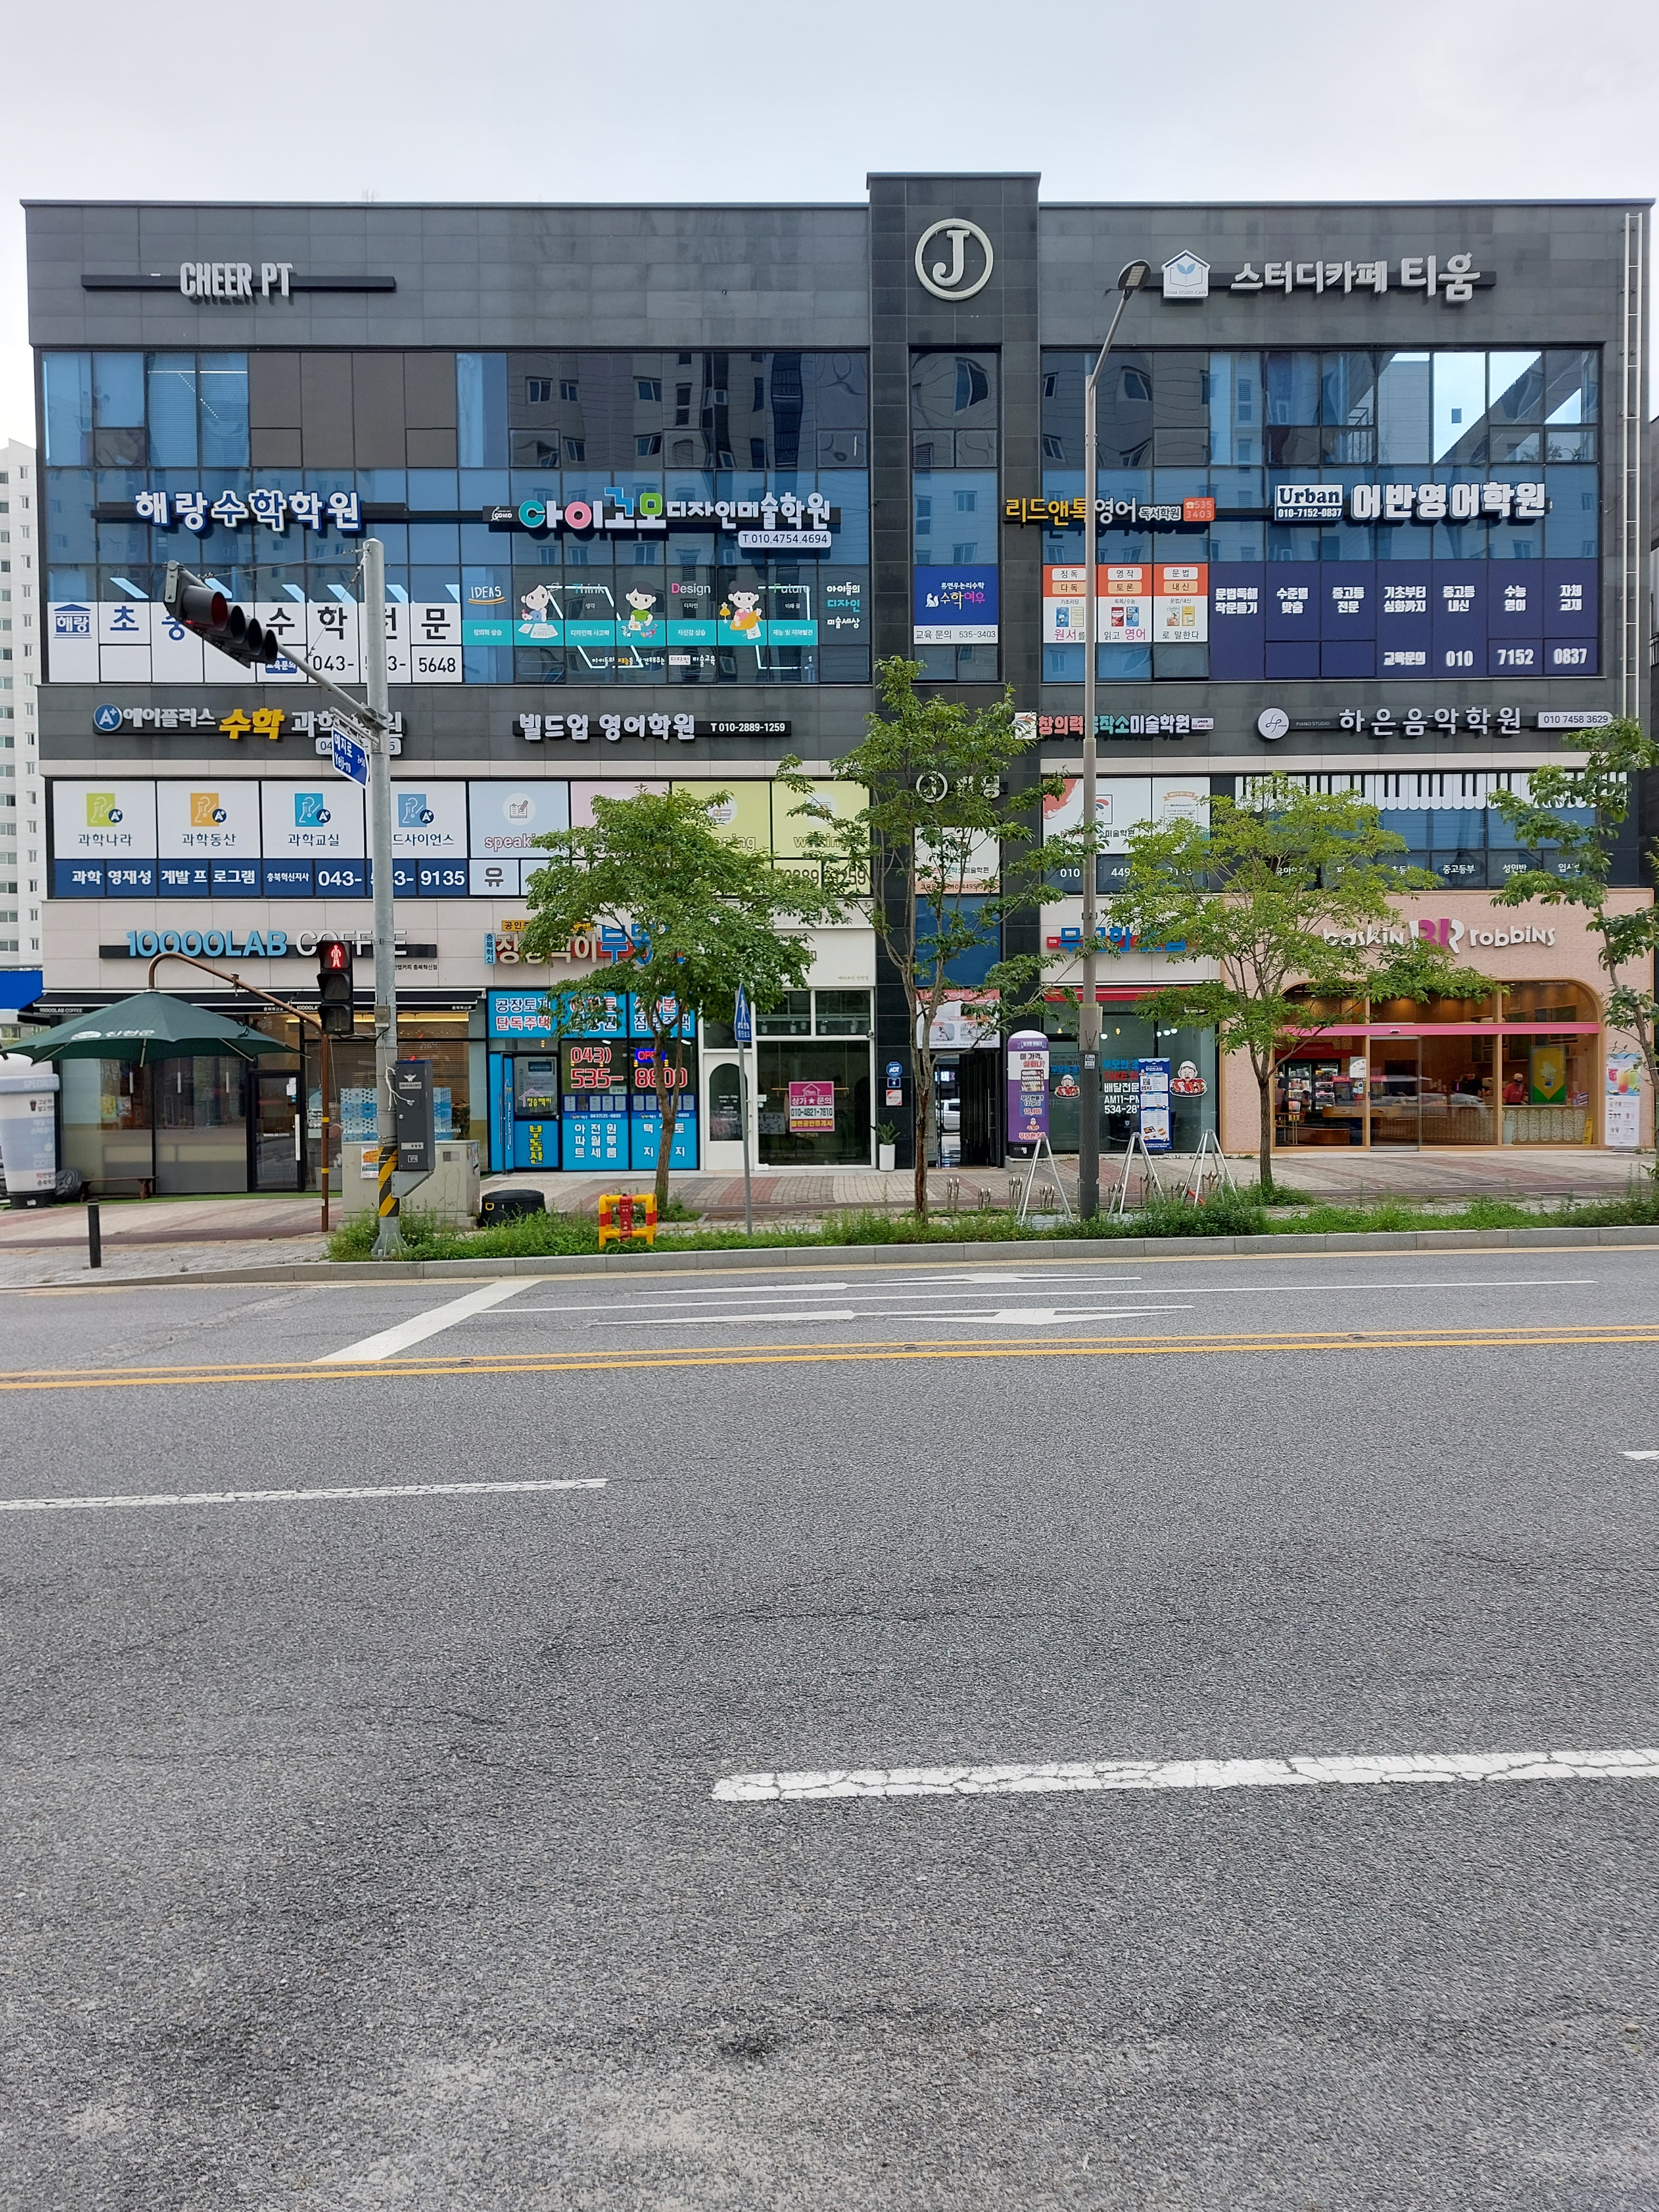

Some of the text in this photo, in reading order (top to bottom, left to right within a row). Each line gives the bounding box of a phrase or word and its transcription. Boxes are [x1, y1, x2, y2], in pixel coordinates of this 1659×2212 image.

[933, 230, 970, 286] J
[180, 261, 293, 297] CHEER PT
[1231, 252, 1481, 302] 스터디카페 티움
[1279, 487, 1340, 505] Urban
[1351, 482, 1546, 520] 어반영어학원
[135, 489, 362, 532] 해랑수학학원
[666, 492, 830, 530] 디자인미술학원
[1195, 500, 1212, 509] 535
[1139, 506, 1182, 521] 독서학원
[1186, 510, 1212, 519] 3403
[1278, 508, 1342, 518] 010-7152-0837
[1061, 569, 1078, 579] 정독
[1116, 569, 1135, 578] 영작
[1172, 569, 1190, 578] 문법
[470, 586, 501, 598] IDEAS
[671, 583, 711, 596] Design
[826, 581, 861, 596] 아이들의
[1061, 583, 1078, 593] 다독
[1116, 583, 1135, 592] 토론
[1172, 582, 1190, 591] 내신
[1215, 587, 1259, 600] 문법독해
[1276, 586, 1309, 600] 수준별
[1332, 586, 1365, 599] 중고등
[1384, 586, 1427, 599] 기초부터
[1442, 585, 1476, 598] 중고등
[1504, 585, 1527, 598] 수능
[1559, 584, 1582, 597] 자체
[827, 599, 861, 613] 디자인
[940, 591, 985, 610] 수학여우
[1281, 601, 1304, 614] 맞춤
[1337, 600, 1360, 614] 전문
[1383, 600, 1427, 613] 심화까지
[1448, 599, 1470, 612] 내신
[1504, 598, 1526, 612] 영어
[1559, 598, 1582, 611] 교재
[1215, 601, 1258, 615] 작문듣기
[56, 616, 89, 633] 해랑
[827, 616, 861, 629] 미술세상
[915, 630, 932, 640] 교육
[935, 630, 952, 640] 문의
[1054, 629, 1086, 641] 원서를
[1104, 631, 1120, 640] 읽고
[1125, 628, 1146, 641] 영어
[1174, 630, 1200, 640] 말한다
[1383, 651, 1426, 665] 교육문의
[1446, 648, 1587, 667] 010 7152 0837
[419, 657, 456, 673] 5648
[122, 708, 285, 740] 에이플러스 수학
[519, 713, 589, 740] 빌드업
[599, 712, 695, 741] 영어학원
[719, 722, 785, 732] 010-2889-1259
[1338, 707, 1521, 736] 하은음악학원
[1544, 715, 1608, 724] 010 7458 3629
[78, 833, 133, 847] 과학나라
[182, 833, 236, 847] 과학동산
[288, 833, 340, 847] 과학교실
[1060, 868, 1081, 878] 010
[1443, 864, 1476, 874] 중고등부
[1503, 863, 1527, 874] 성인반
[72, 870, 102, 885] 과학
[107, 870, 152, 885] 영재성
[193, 869, 255, 885] 프로그램
[420, 870, 465, 886] 9135
[1323, 924, 1405, 947] baskin
[126, 929, 288, 957] 10000LAB
[571, 1047, 611, 1063] 043)
[571, 1068, 624, 1089] 535-
[1104, 1082, 1139, 1093] 배달전문
[792, 1096, 832, 1106] 상가 문의
